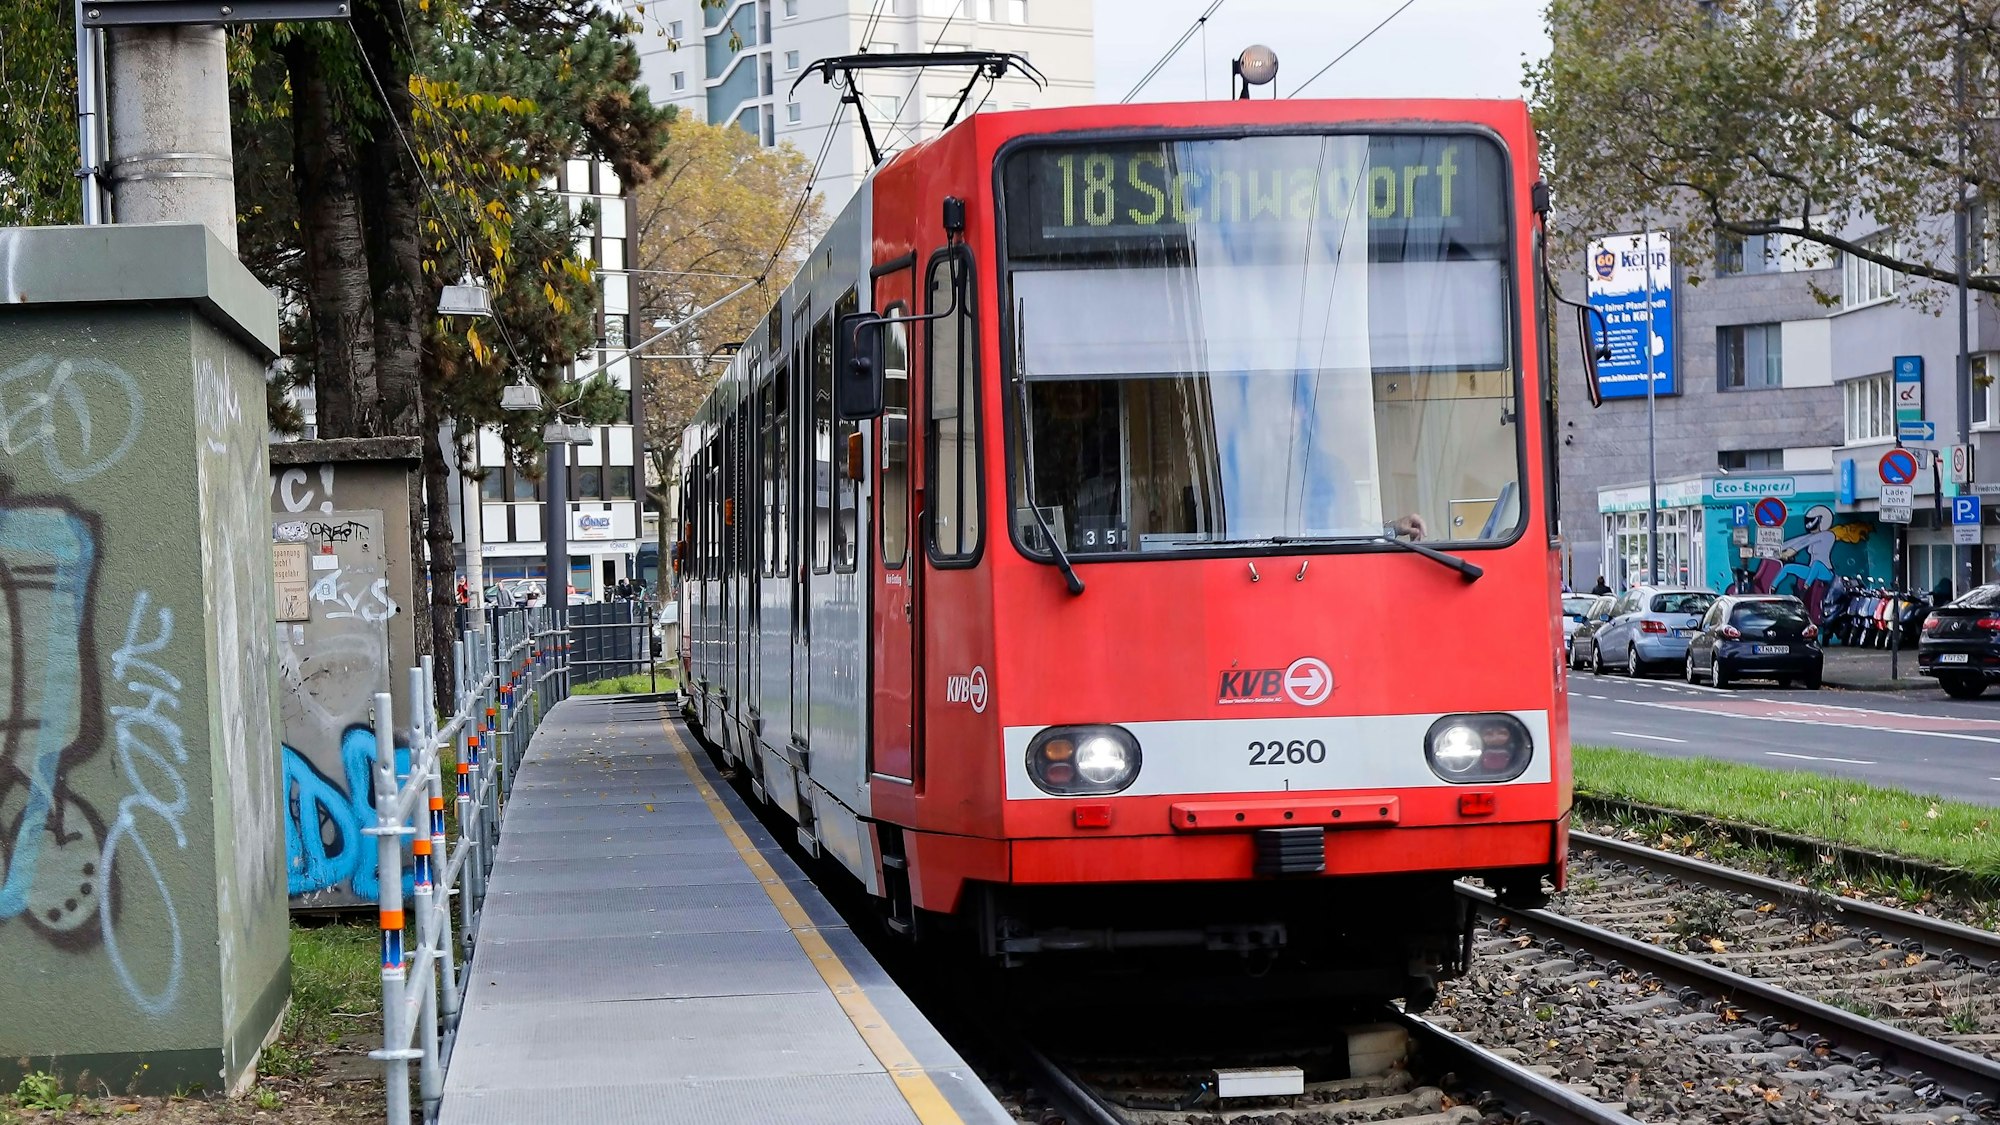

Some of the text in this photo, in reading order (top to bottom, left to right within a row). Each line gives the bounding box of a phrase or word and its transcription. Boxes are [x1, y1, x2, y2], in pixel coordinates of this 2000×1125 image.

[1058, 145, 1458, 227] 18 Schwadorf
[1597, 254, 1614, 267] 60
[1625, 299, 1667, 311] Pfandredit
[269, 464, 334, 515] C!
[273, 550, 301, 560] spannung
[274, 559, 292, 567] sicht!
[275, 570, 299, 579] nsgefahr
[947, 676, 971, 702] KVB
[1219, 671, 1283, 698] KVB
[1247, 739, 1327, 766] 2260
